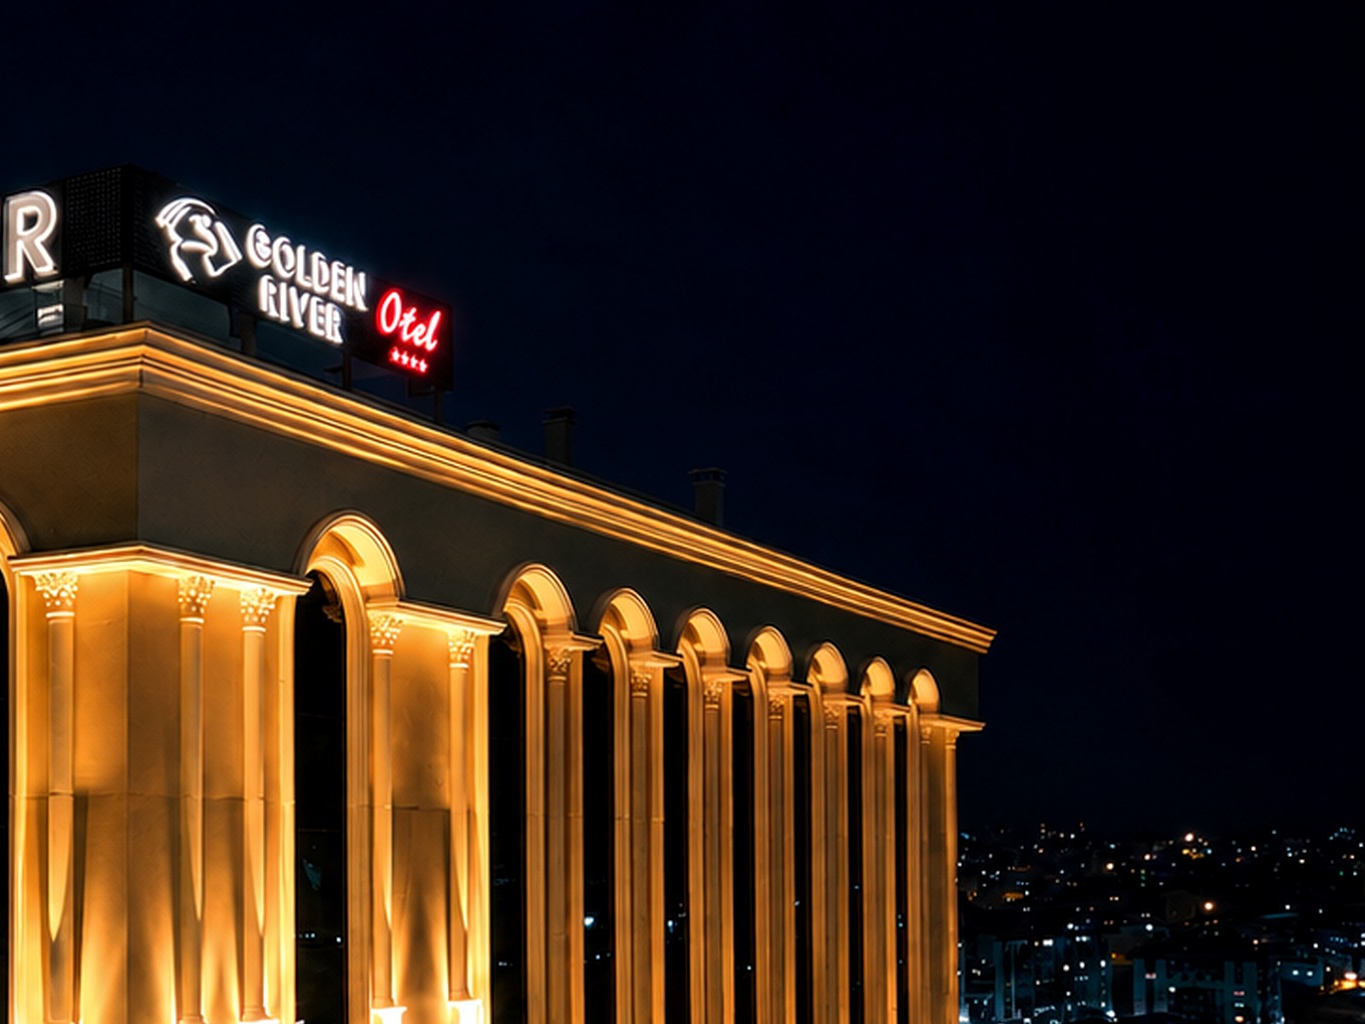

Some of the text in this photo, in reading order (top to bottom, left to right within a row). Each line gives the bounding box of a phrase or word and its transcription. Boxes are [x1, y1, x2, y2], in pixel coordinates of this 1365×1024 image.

[245, 223, 369, 312] GOLDEN
[257, 274, 344, 345] RIVER
[376, 287, 442, 353] Otel
